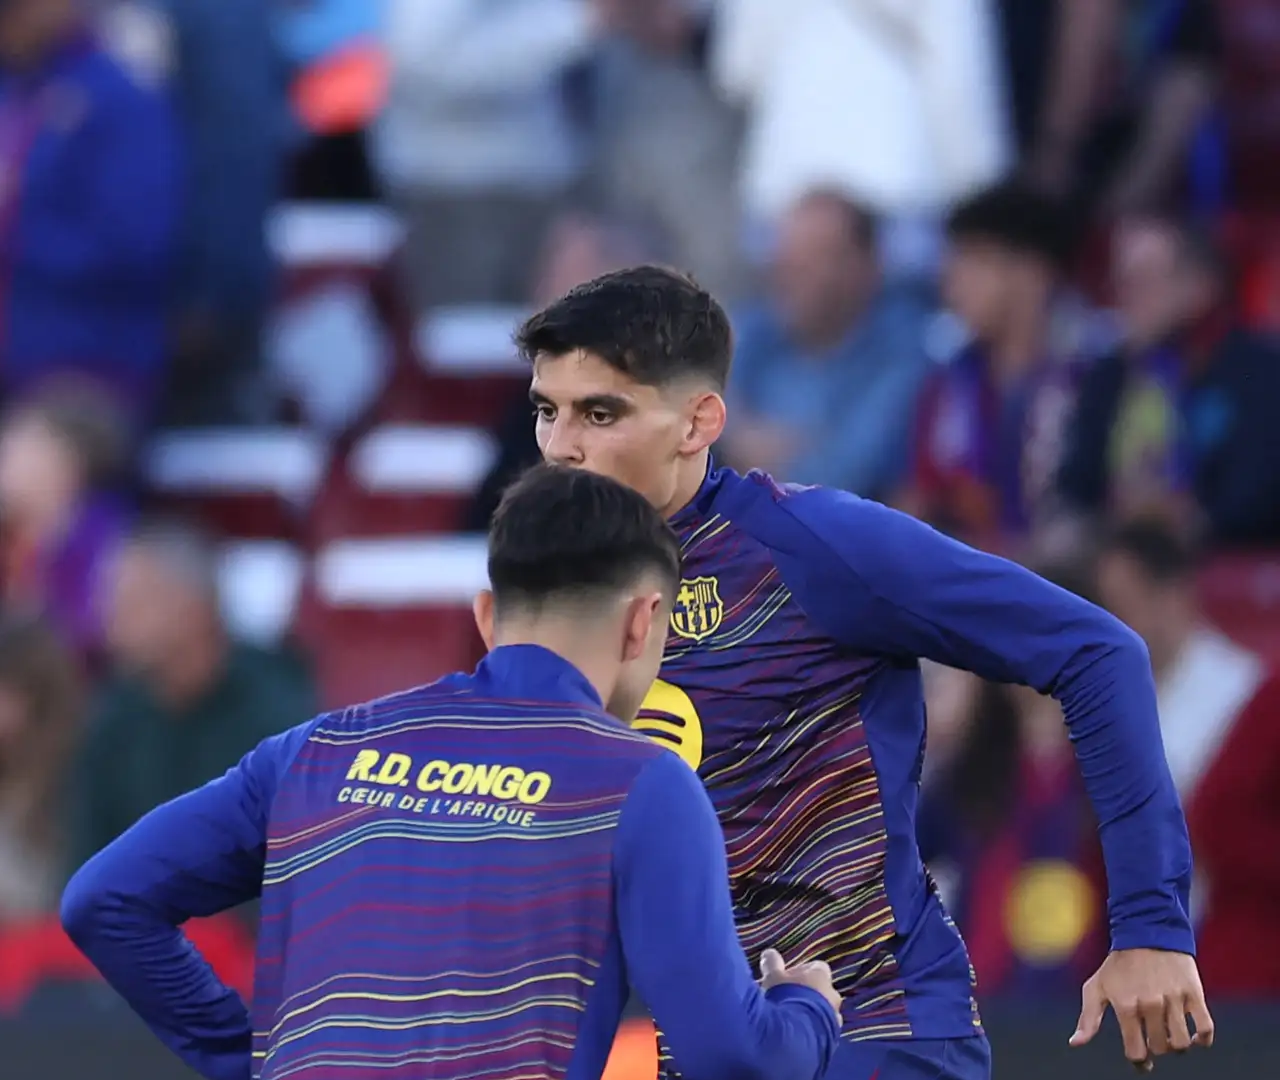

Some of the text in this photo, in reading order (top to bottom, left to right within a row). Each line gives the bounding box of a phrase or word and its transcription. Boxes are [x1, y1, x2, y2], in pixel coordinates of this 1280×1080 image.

[346, 749, 552, 804] R.D. CONGO
[337, 787, 536, 827] CŒUR DE L'AFRIQUE
